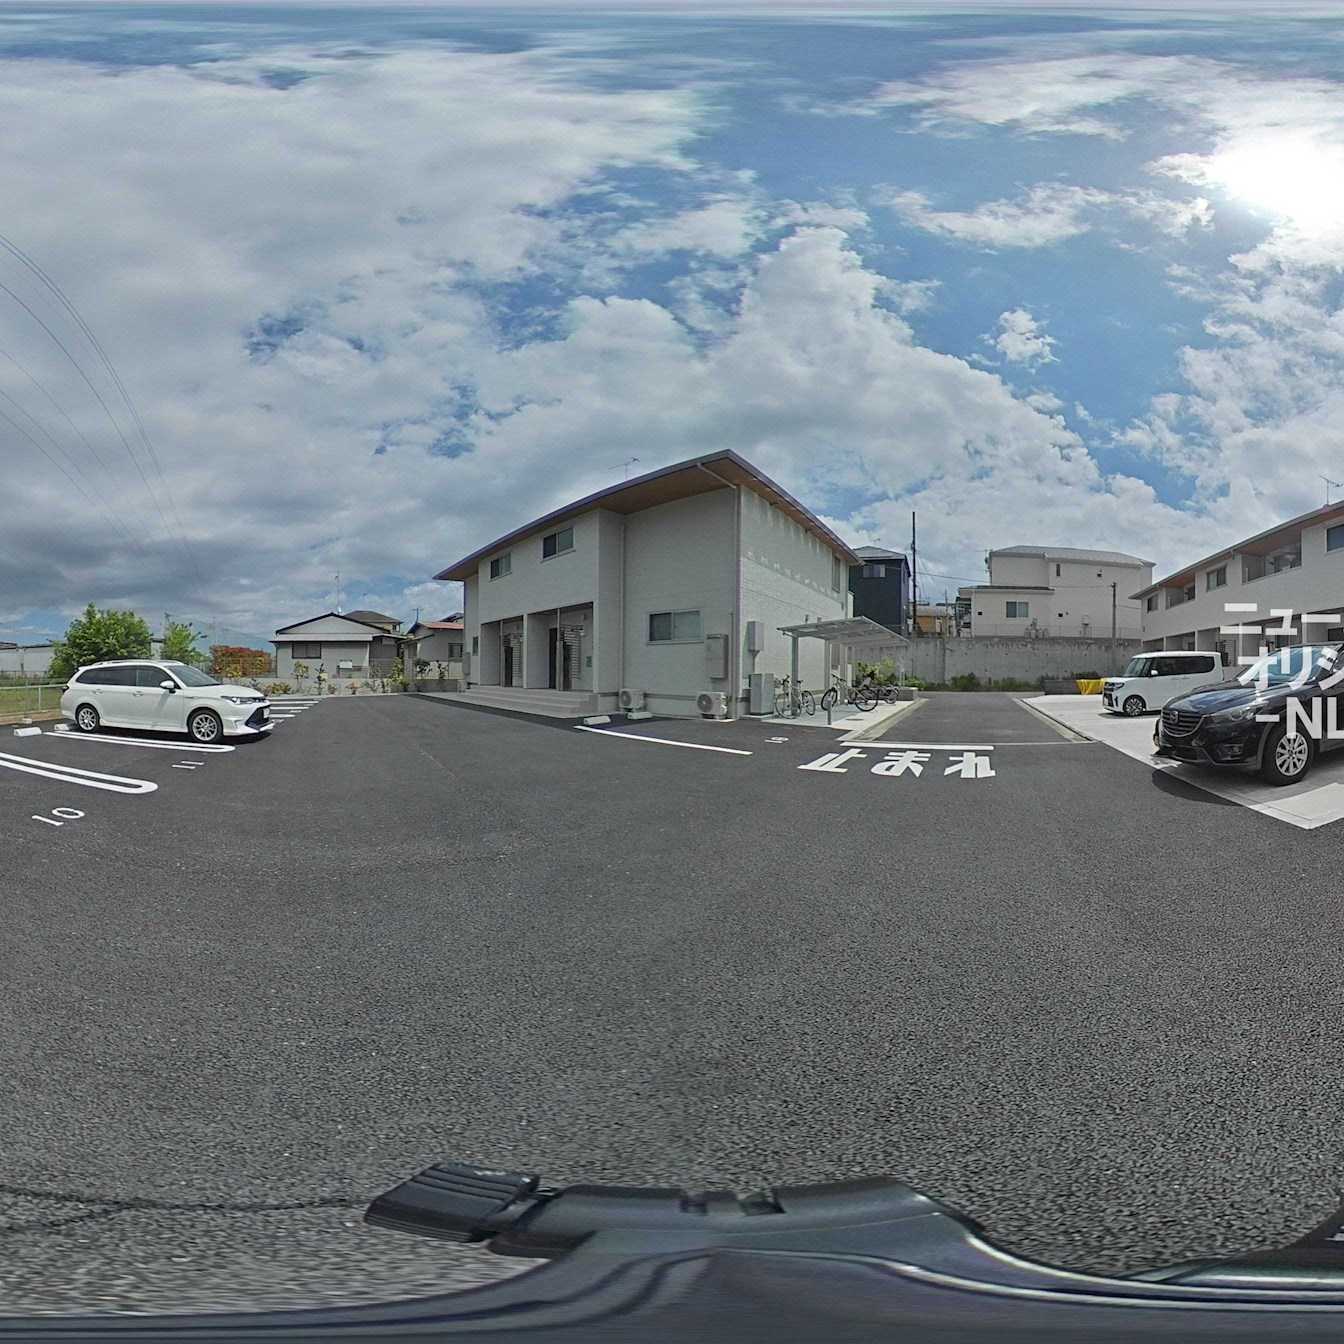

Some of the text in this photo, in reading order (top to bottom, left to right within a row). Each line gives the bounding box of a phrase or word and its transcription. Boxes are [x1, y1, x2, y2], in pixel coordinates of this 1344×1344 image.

[797, 748, 996, 779] 止まれ
[31, 807, 86, 827] 10
